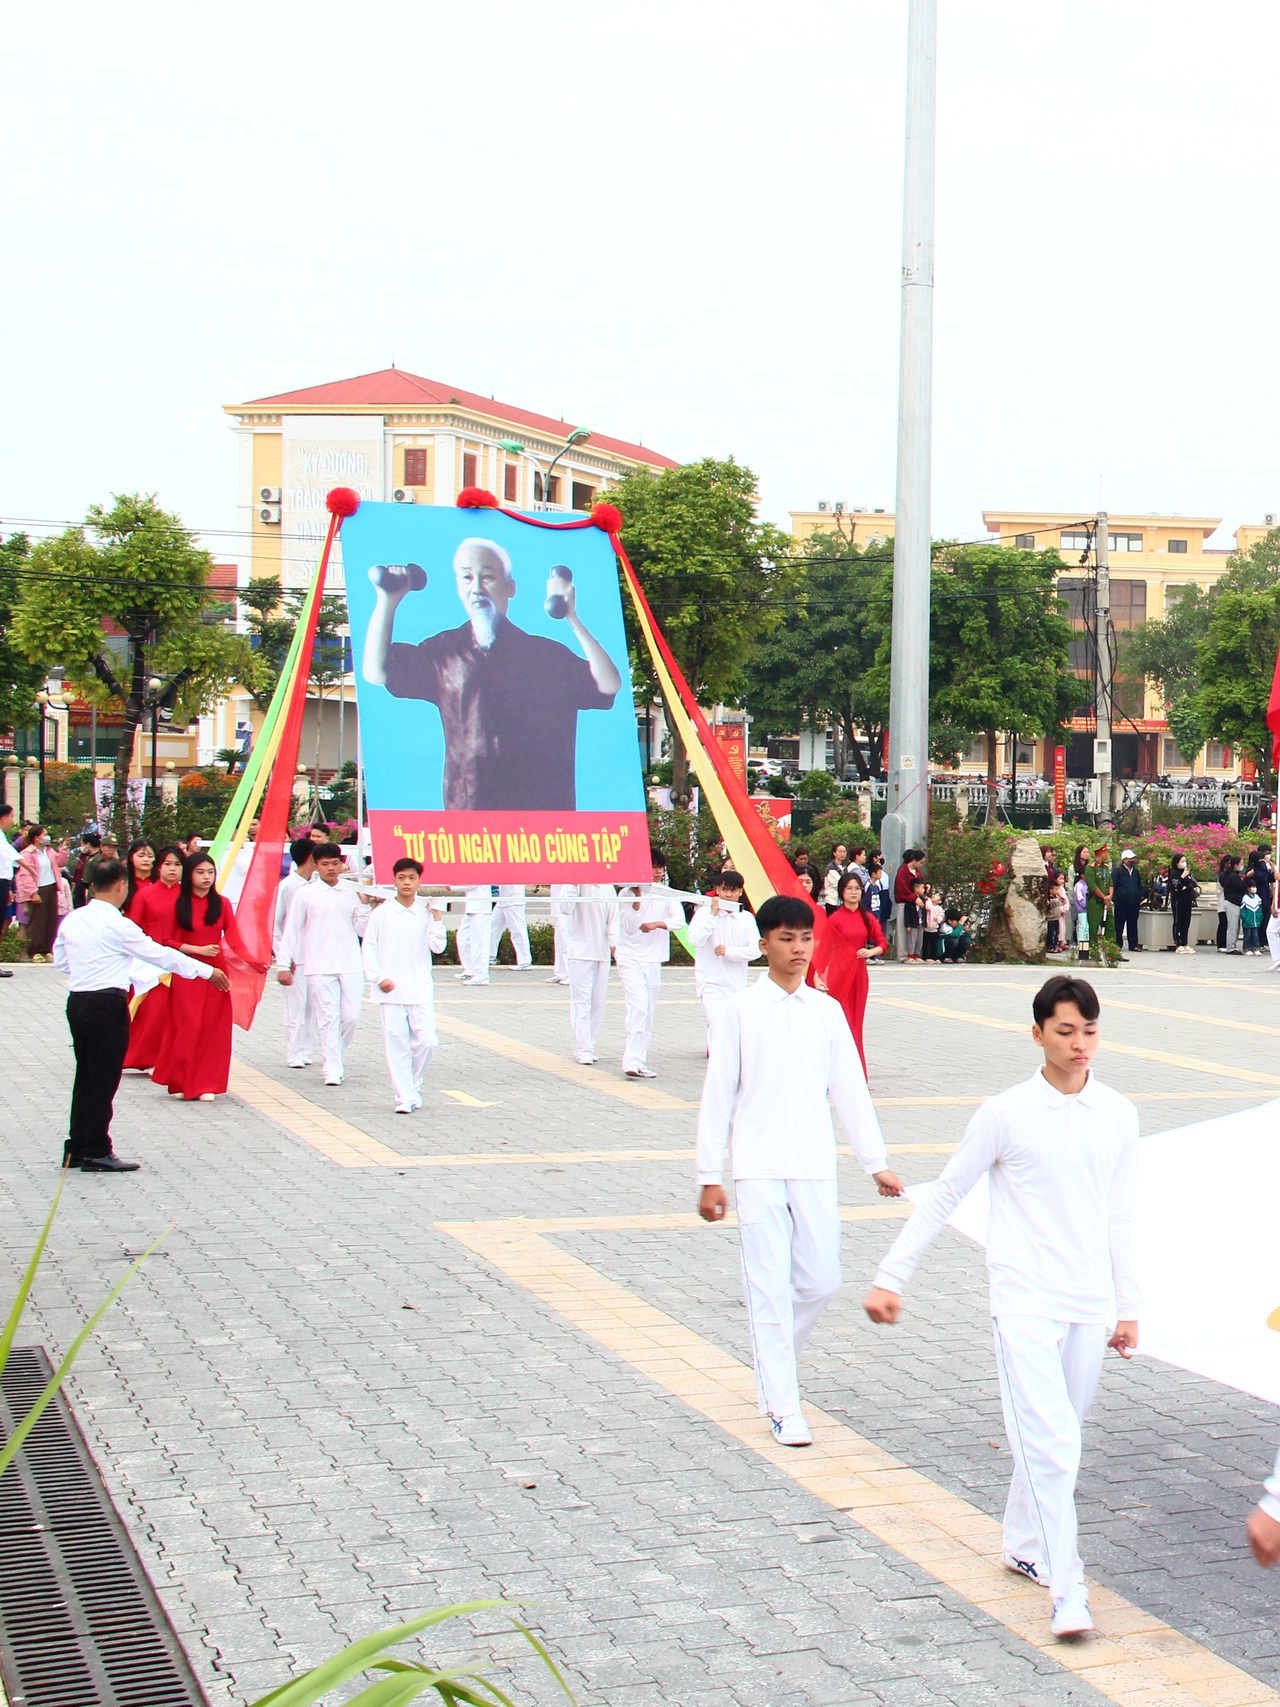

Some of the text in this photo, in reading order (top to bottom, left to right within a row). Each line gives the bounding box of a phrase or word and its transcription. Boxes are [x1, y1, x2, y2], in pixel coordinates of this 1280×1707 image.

[428, 827, 456, 864] TÔI
[458, 828, 502, 863] NGÀY
[506, 827, 541, 863] NÀO
[544, 828, 590, 863] CŨNG
[591, 825, 629, 869] TẬP”
